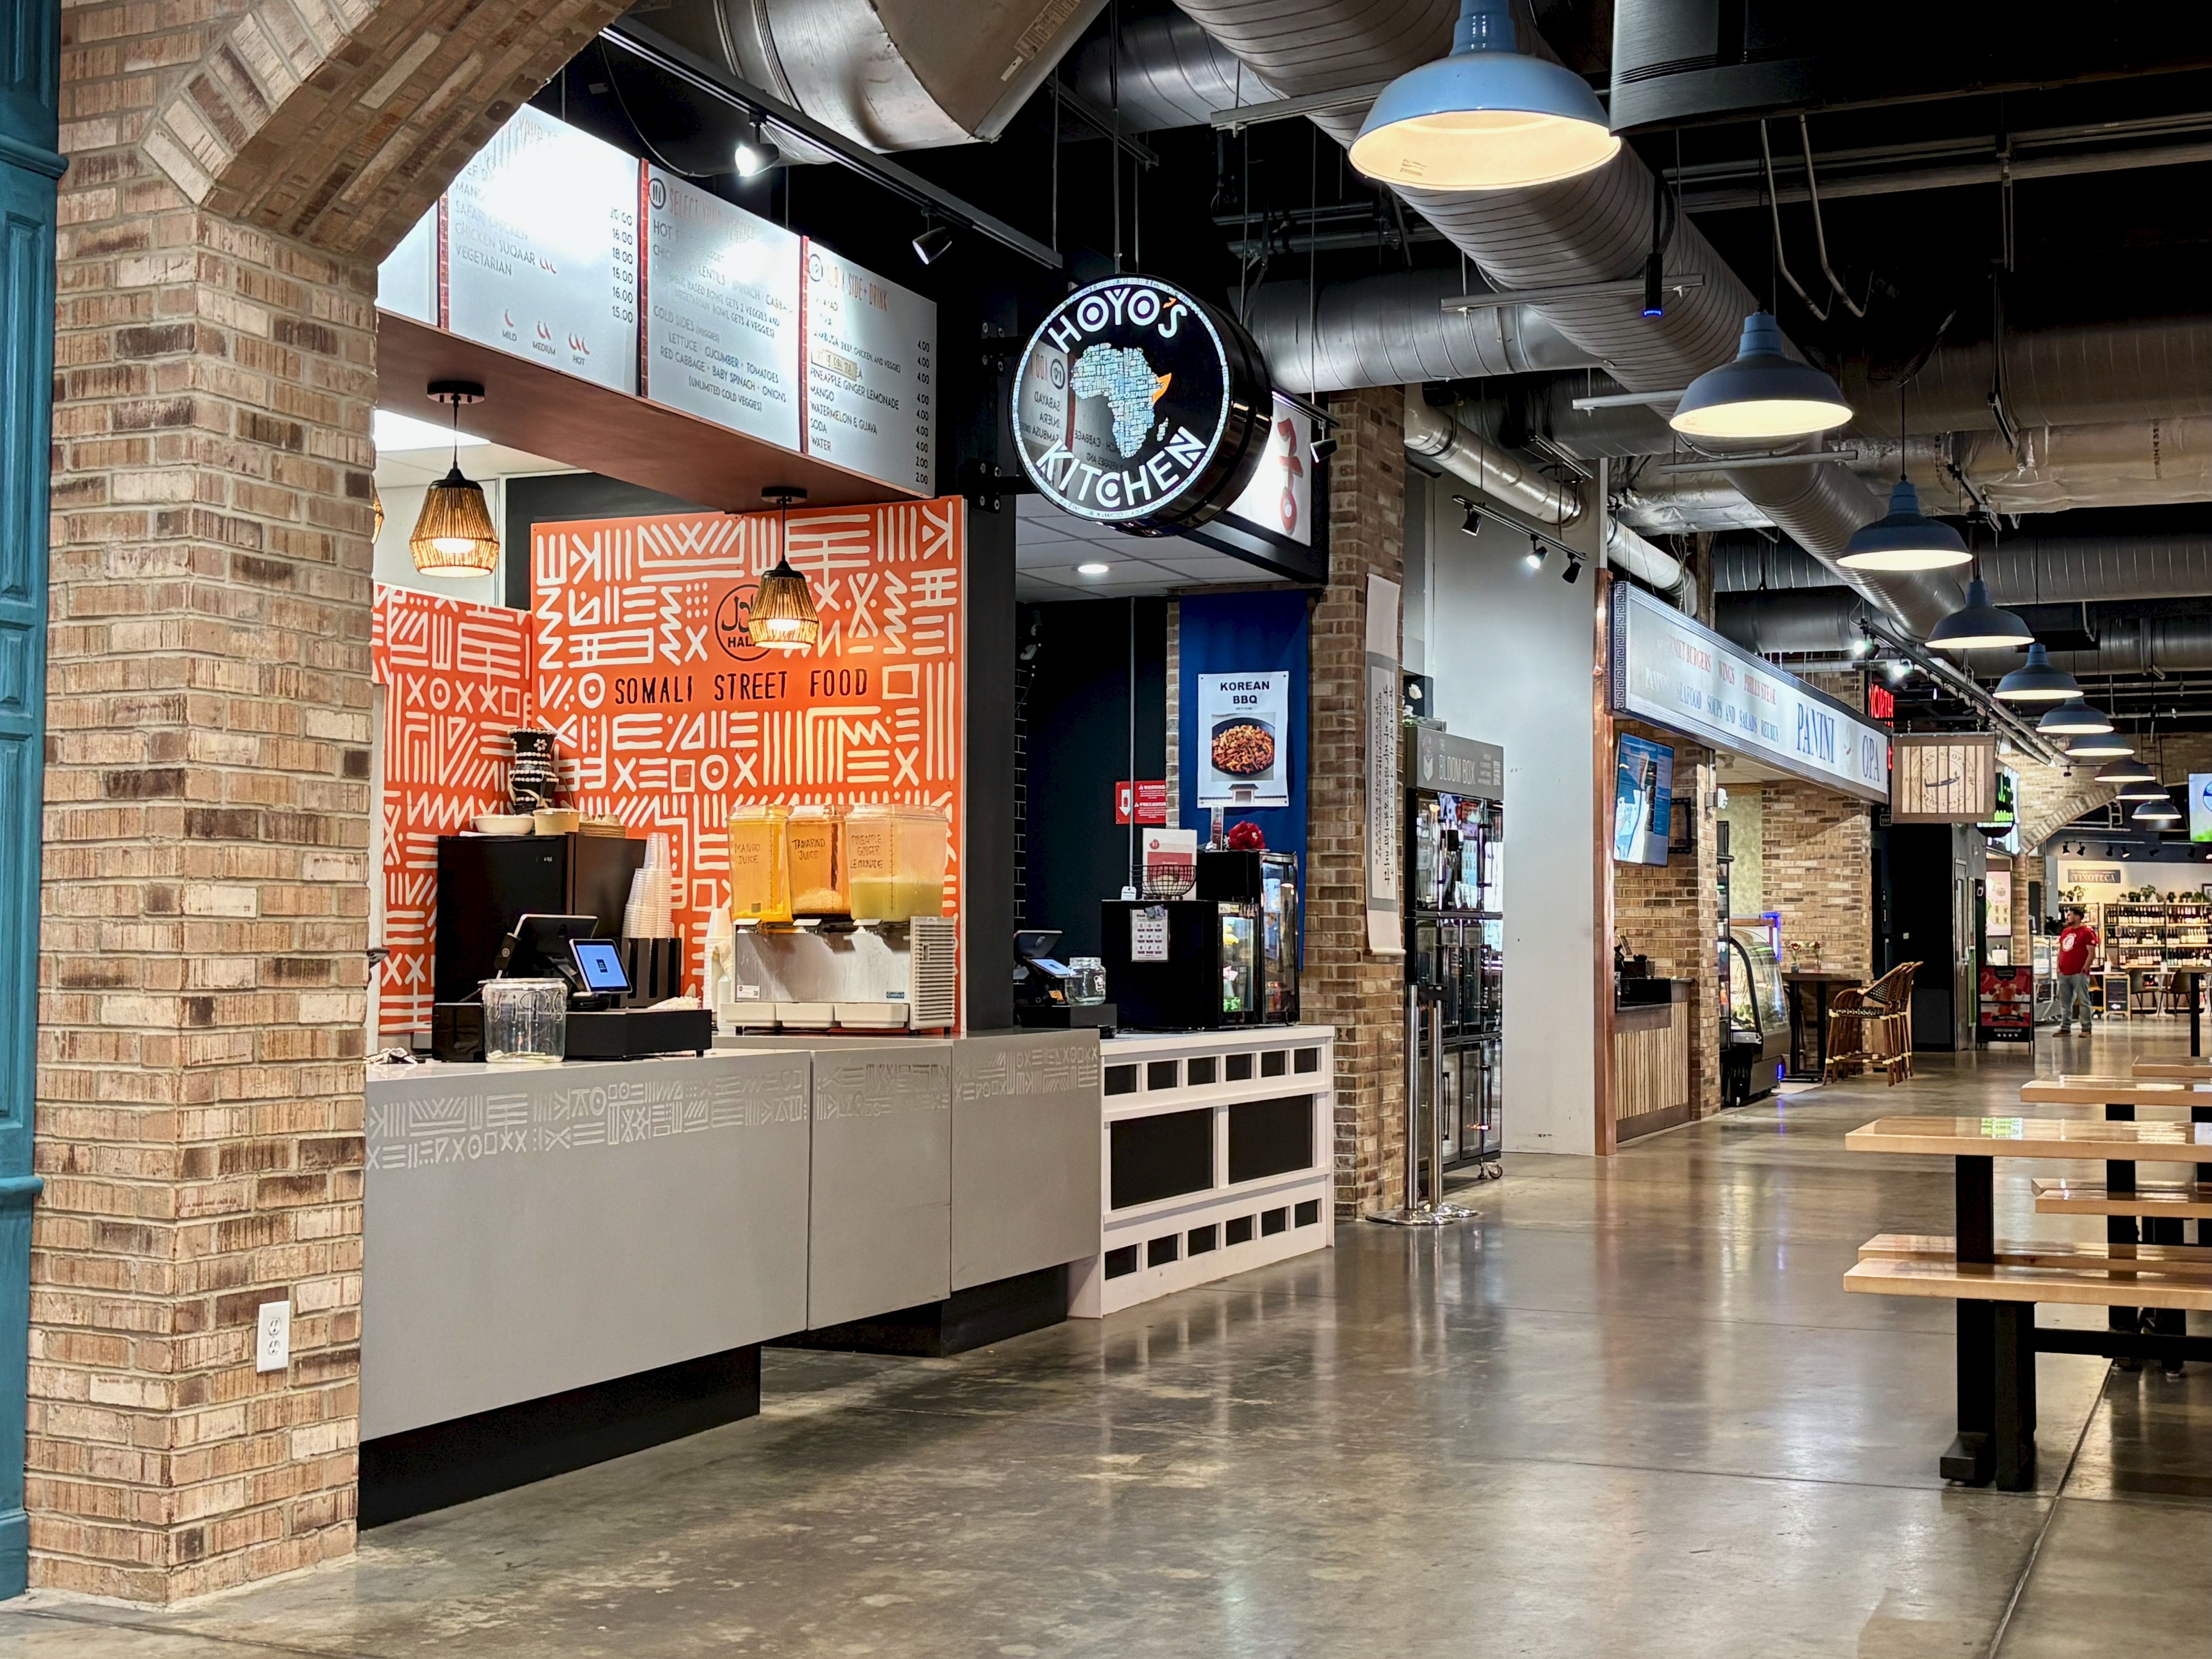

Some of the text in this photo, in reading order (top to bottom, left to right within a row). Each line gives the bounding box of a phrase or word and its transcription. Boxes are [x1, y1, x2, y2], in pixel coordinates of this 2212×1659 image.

[670, 188, 698, 219] SELECT
[455, 220, 495, 249] CHICKEN
[653, 219, 672, 240] HOT
[455, 243, 512, 276] VEGETARIAN
[612, 247, 633, 264] 18.00
[613, 286, 633, 304] 16.00
[848, 273, 862, 301] SIDE
[869, 282, 888, 312] DRINK
[612, 305, 633, 323] 15.00
[653, 306, 674, 323] COLD
[676, 315, 694, 332] SIDES
[1048, 287, 1188, 354] HOYO'S
[573, 354, 585, 365] HOT
[660, 345, 673, 360] RED
[675, 352, 705, 373] CABBAGE
[712, 365, 728, 381] BABY
[730, 373, 755, 391] SPINACH
[668, 332, 779, 384] LETTUCE CUCUMBER TOMATOES
[688, 375, 763, 413] (UNLIMITED COLD VEGGIES)
[810, 367, 899, 410] PINEAPPLE GINGER LEMONADE
[810, 385, 834, 402] MANGO
[810, 401, 852, 425] WATERMELON
[810, 418, 827, 434] SODA
[811, 435, 832, 452] WATER
[1036, 426, 1206, 509] KITCHEN
[728, 635, 755, 648] HAL
[1686, 643, 1711, 673] BURGERS
[1718, 660, 1735, 685] WINGS
[615, 668, 868, 704] SOMALI STREET FOOD
[1220, 680, 1270, 692] KOREAN
[1233, 695, 1257, 704] BBQ
[1796, 702, 1835, 764] PANINI
[1862, 734, 1880, 782] OPA
[1439, 754, 1461, 783] BLOOM
[1462, 759, 1476, 785] BOX
[734, 843, 760, 853] MANGO
[738, 855, 759, 865] JUICE
[799, 850, 819, 861] JUICE
[2073, 874, 2115, 882] VINOTECA
